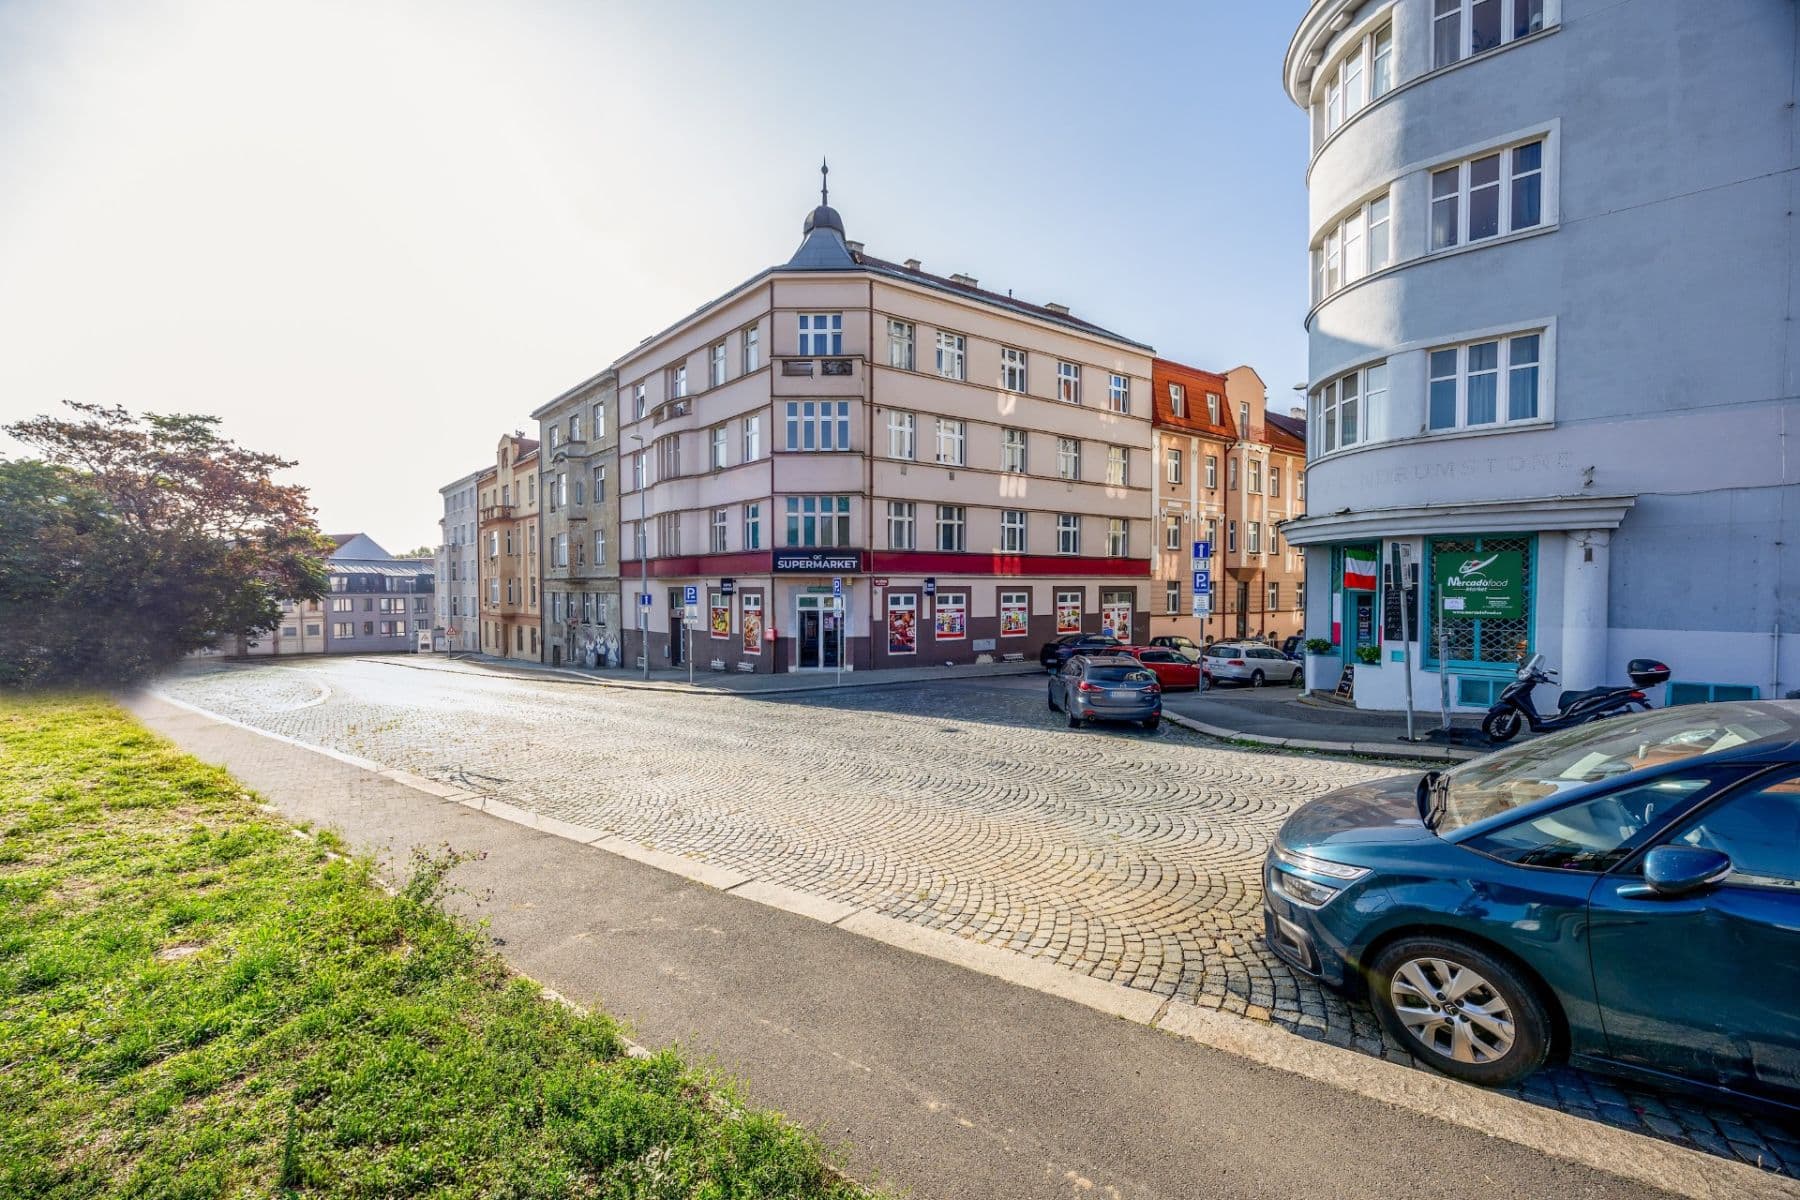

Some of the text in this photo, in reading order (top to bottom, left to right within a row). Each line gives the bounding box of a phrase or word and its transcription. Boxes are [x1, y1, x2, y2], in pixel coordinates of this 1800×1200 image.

[777, 560, 858, 569] SUPERMARKET
[1196, 573, 1206, 588] P
[687, 587, 696, 600] P
